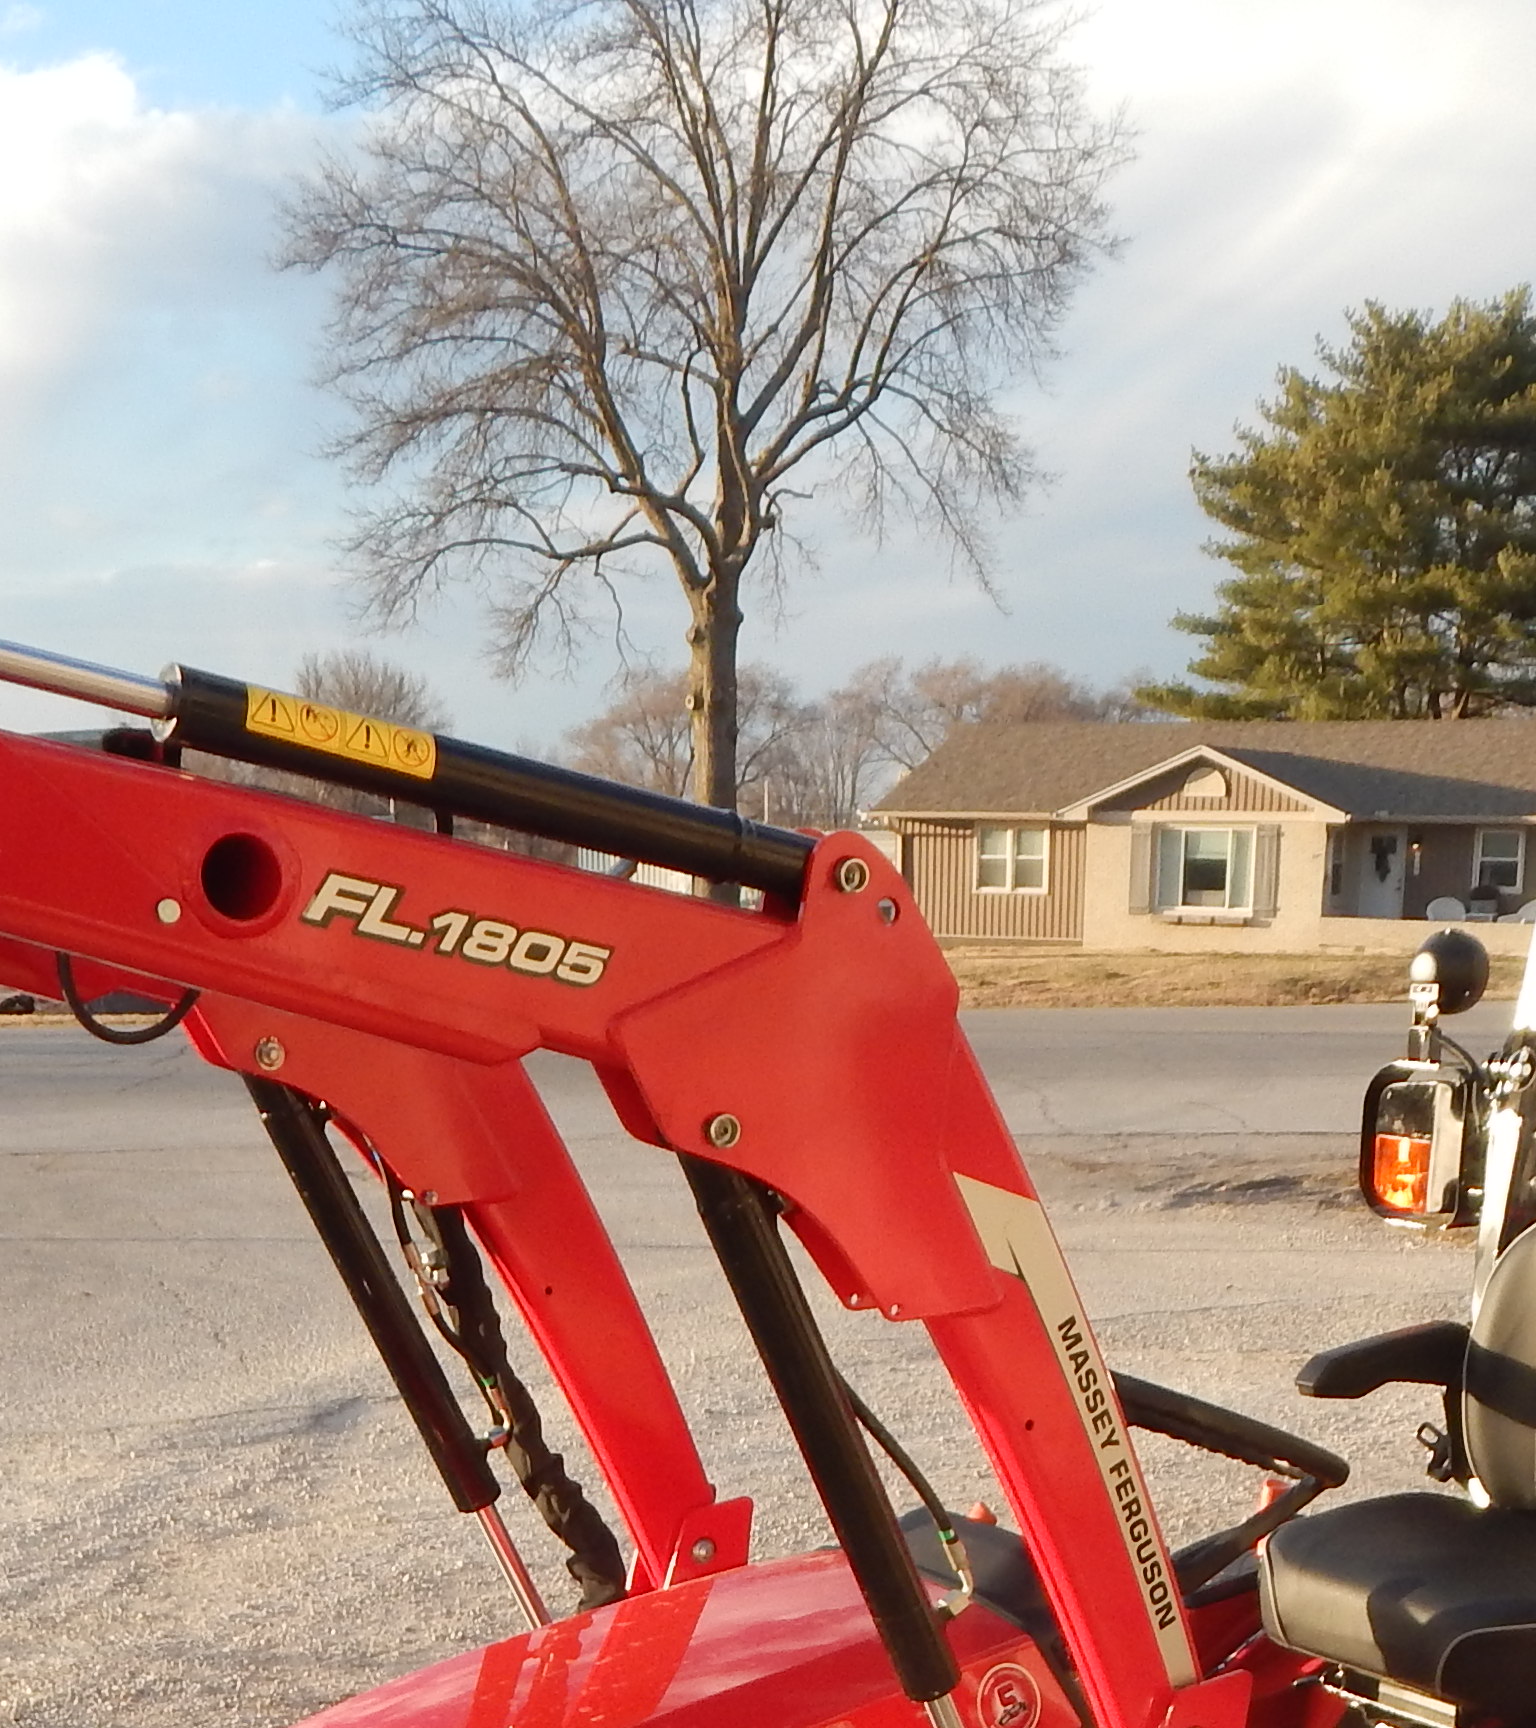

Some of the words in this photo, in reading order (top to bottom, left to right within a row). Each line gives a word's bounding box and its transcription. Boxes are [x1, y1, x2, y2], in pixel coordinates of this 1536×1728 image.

[302, 872, 611, 986] FL.1805
[1057, 1315, 1121, 1450] MASSEY
[1109, 1458, 1177, 1631] FERGUSON
